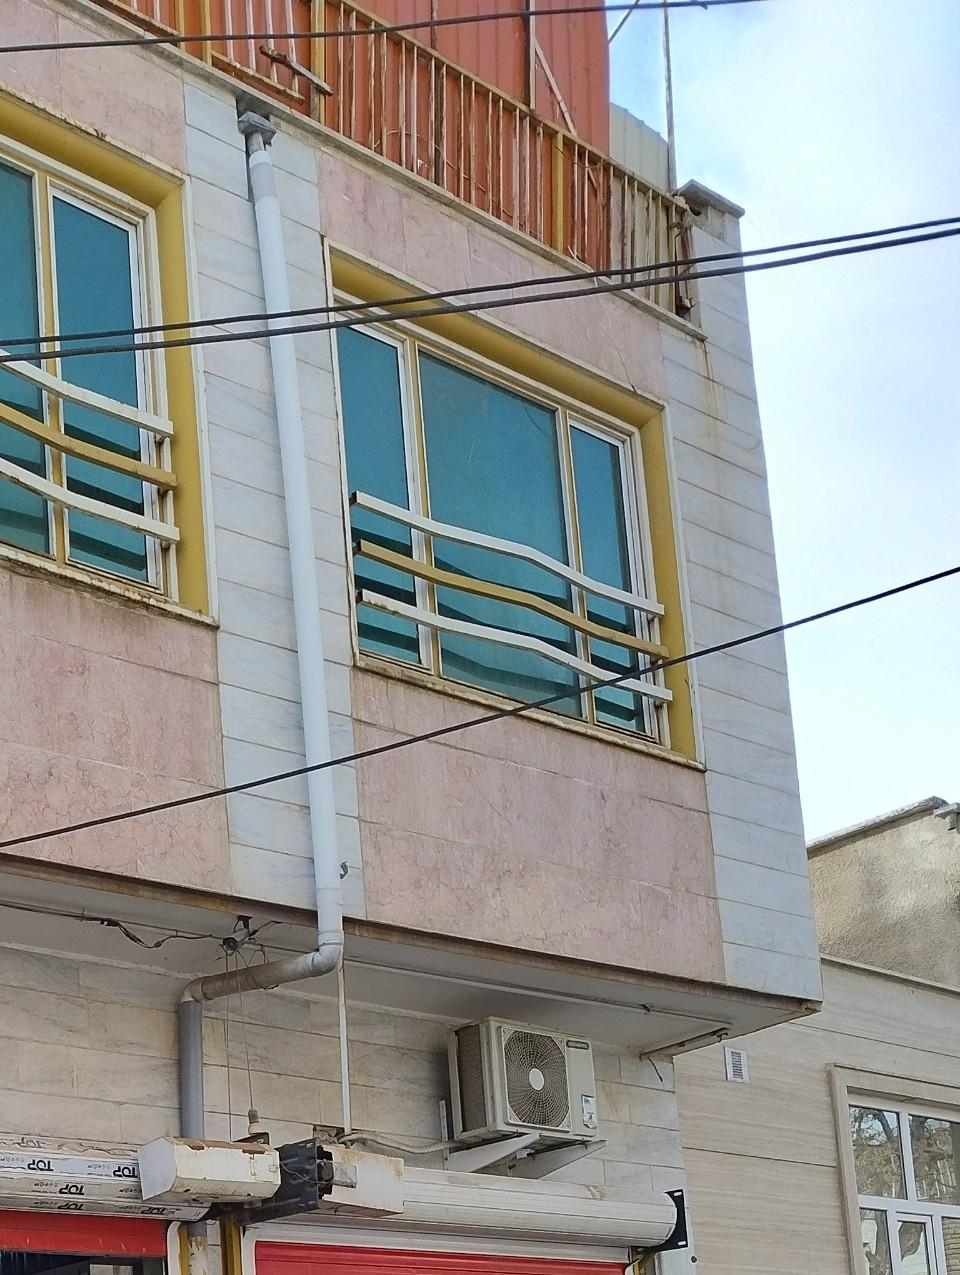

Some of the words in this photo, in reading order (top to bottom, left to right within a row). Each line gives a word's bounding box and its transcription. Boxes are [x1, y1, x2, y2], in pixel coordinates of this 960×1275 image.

[27, 1158, 53, 1172] TOP
[113, 1165, 138, 1178] TOP
[58, 1183, 85, 1196] TOP
[57, 1201, 84, 1211] TOP
[140, 1206, 166, 1215] TOP
